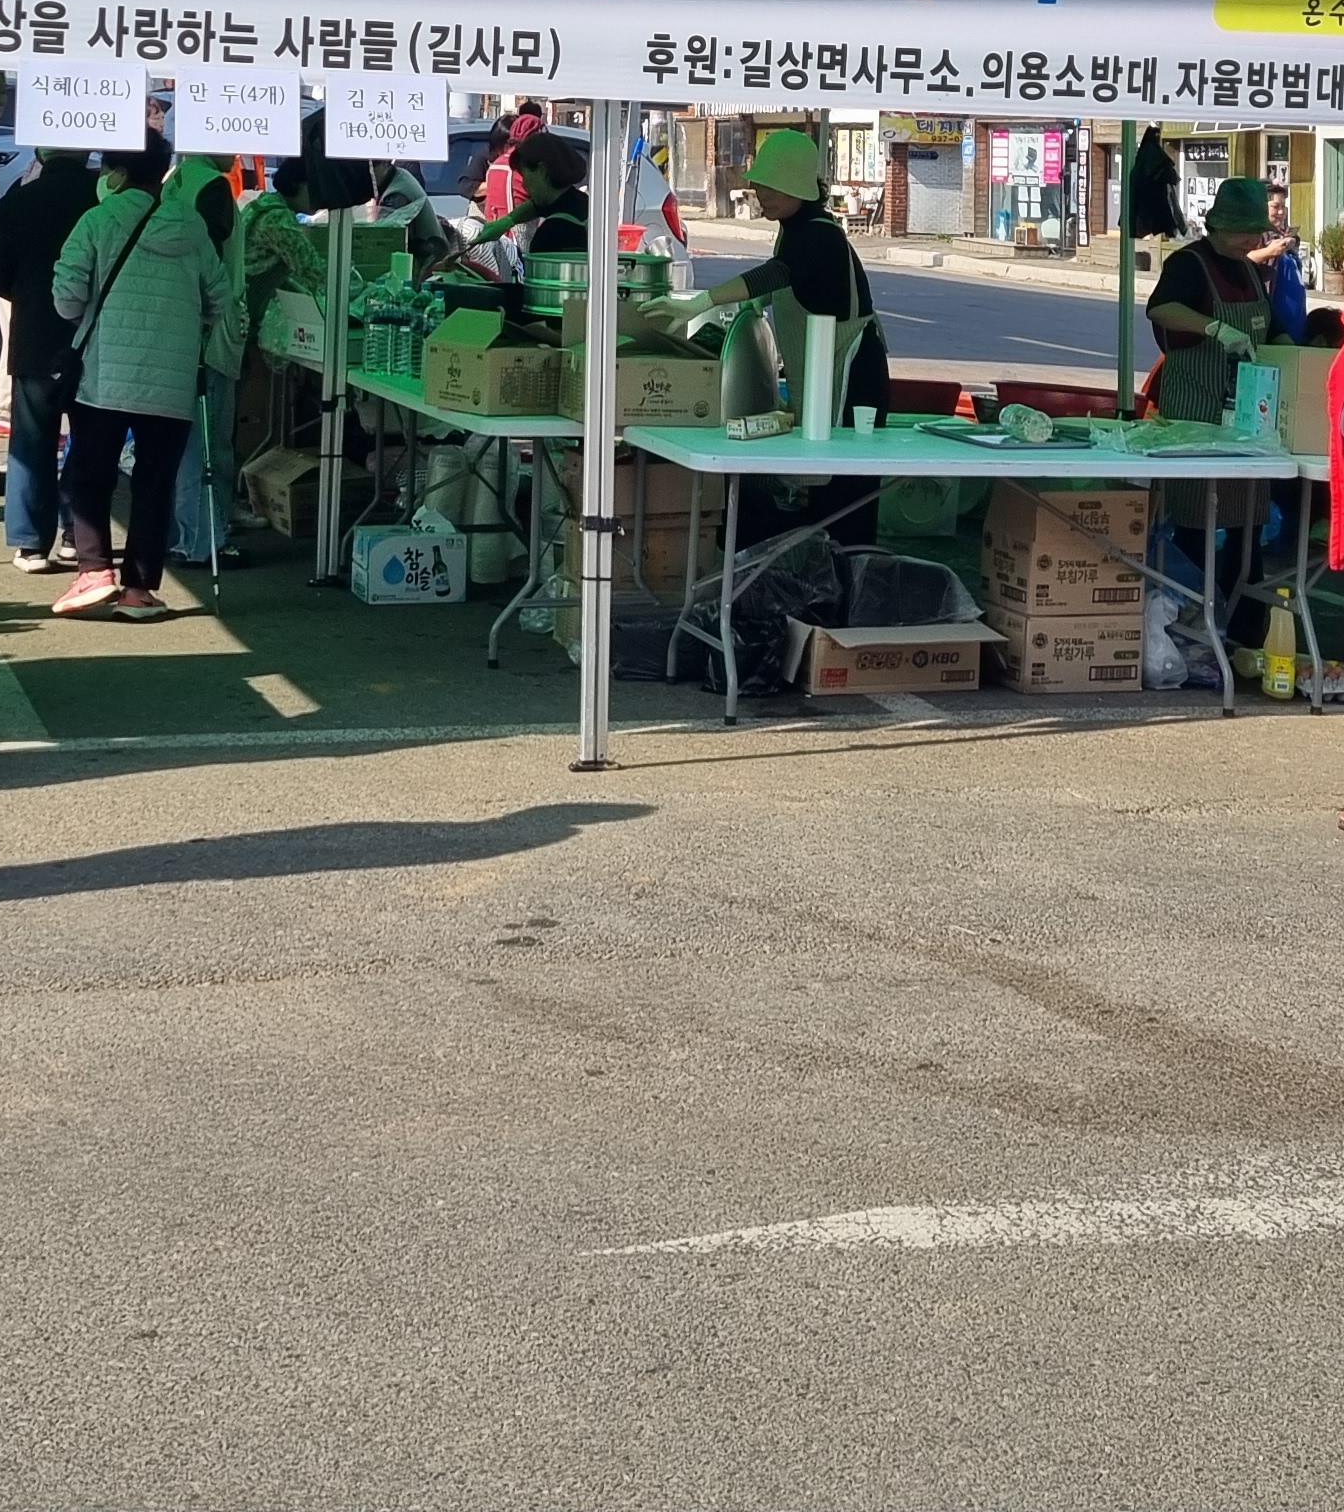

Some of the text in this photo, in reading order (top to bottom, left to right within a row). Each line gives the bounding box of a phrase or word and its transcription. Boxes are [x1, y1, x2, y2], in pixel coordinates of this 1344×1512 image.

[87, 4, 259, 67] 사랑하는
[31, 75, 132, 100] 식혜(1.8L)
[42, 110, 117, 132] 6,000원
[204, 116, 269, 136] 5,000원
[1056, 568, 1099, 584] 부침가루
[931, 652, 960, 665] KBO
[1053, 646, 1096, 662] 부침가루
